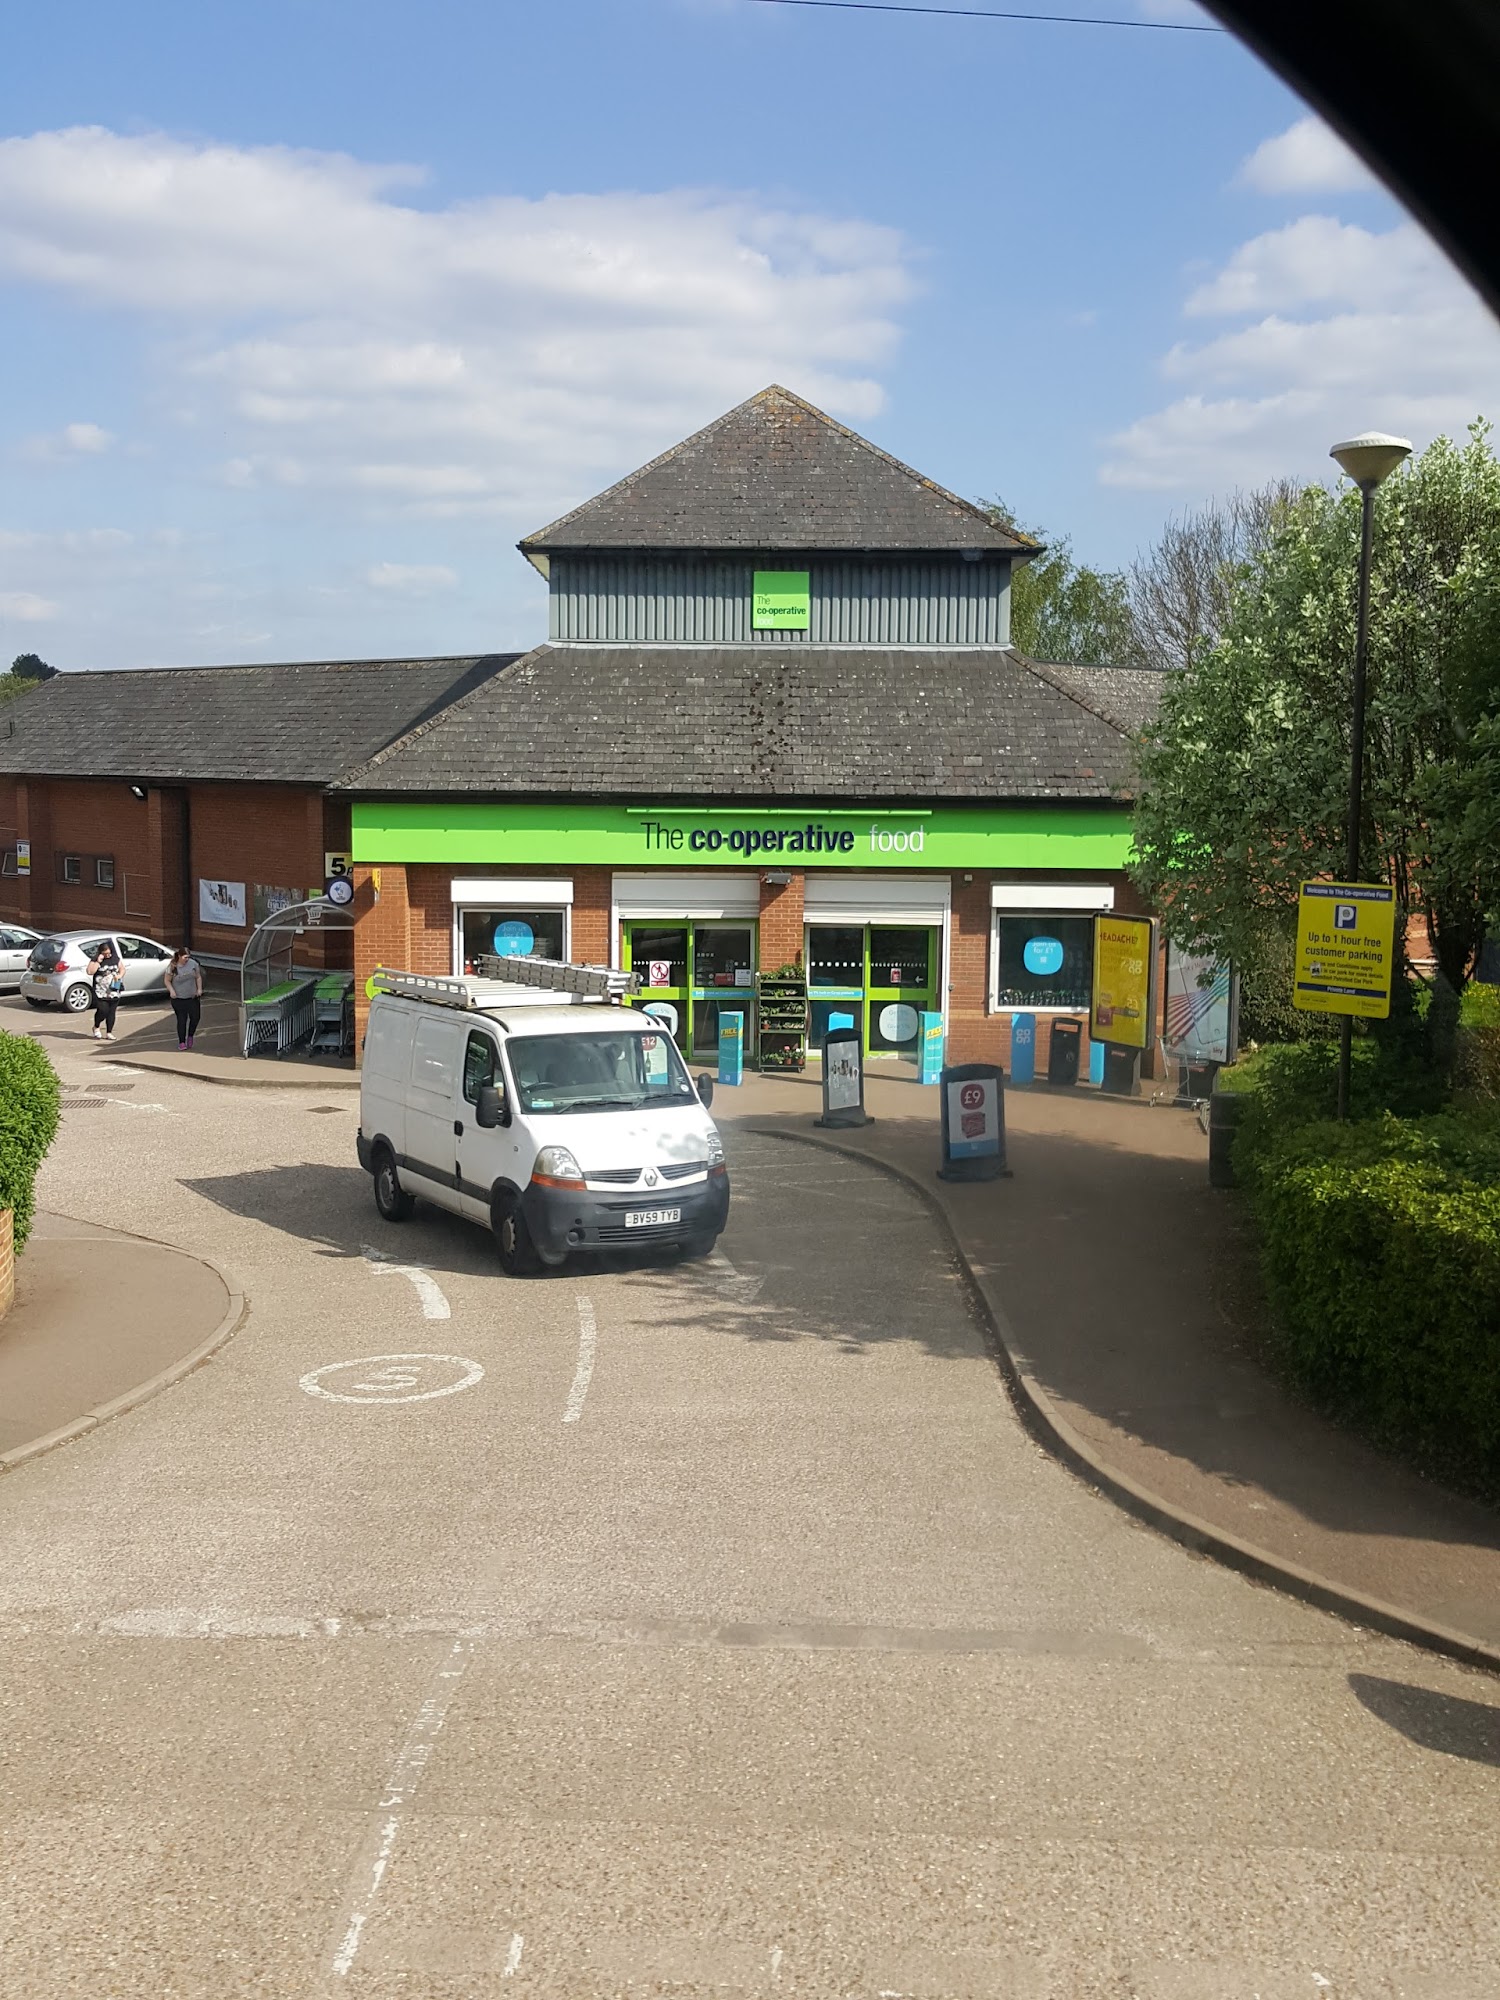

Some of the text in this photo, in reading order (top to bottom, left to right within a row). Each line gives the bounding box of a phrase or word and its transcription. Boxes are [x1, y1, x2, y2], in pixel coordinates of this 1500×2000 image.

[757, 596, 770, 605] The
[757, 606, 806, 616] co-operative
[640, 822, 924, 857] The co-operative food
[1306, 887, 1328, 895] Welcome
[1335, 888, 1344, 896] The
[1344, 889, 1376, 899] Co-operative
[1337, 905, 1355, 928] P
[1308, 931, 1382, 947] Up to 1 hour free
[1305, 946, 1383, 964] customer parking
[964, 1090, 981, 1104] £9
[632, 1209, 679, 1225] BV59 TYB
